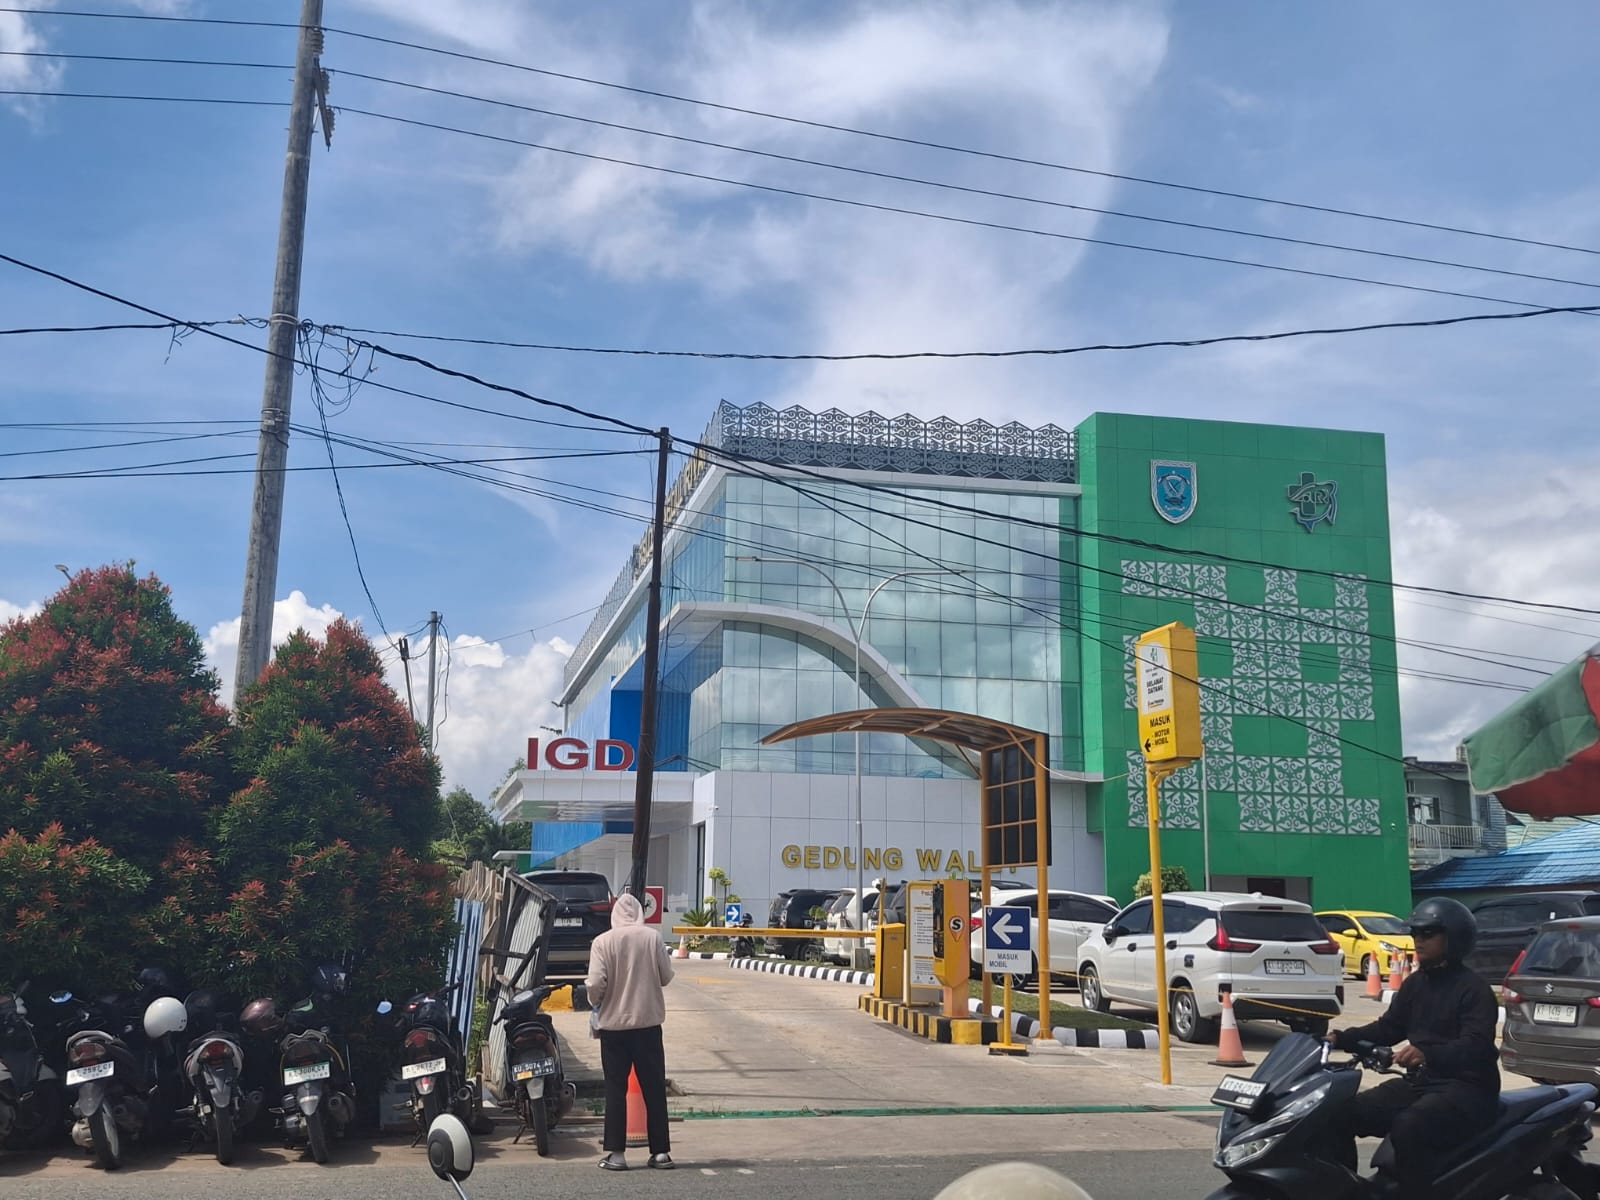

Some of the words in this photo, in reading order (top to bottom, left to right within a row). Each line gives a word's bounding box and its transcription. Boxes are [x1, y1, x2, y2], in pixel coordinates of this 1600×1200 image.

[1149, 714, 1171, 728] MASUK
[1154, 727, 1170, 738] MOTOR
[1154, 737, 1169, 746] MOBIL
[527, 737, 635, 771] IGD
[781, 844, 903, 870] GEDUNG
[916, 848, 1017, 874] WAL
[996, 953, 1019, 961] MASUK
[989, 960, 1008, 968] MOBIL
